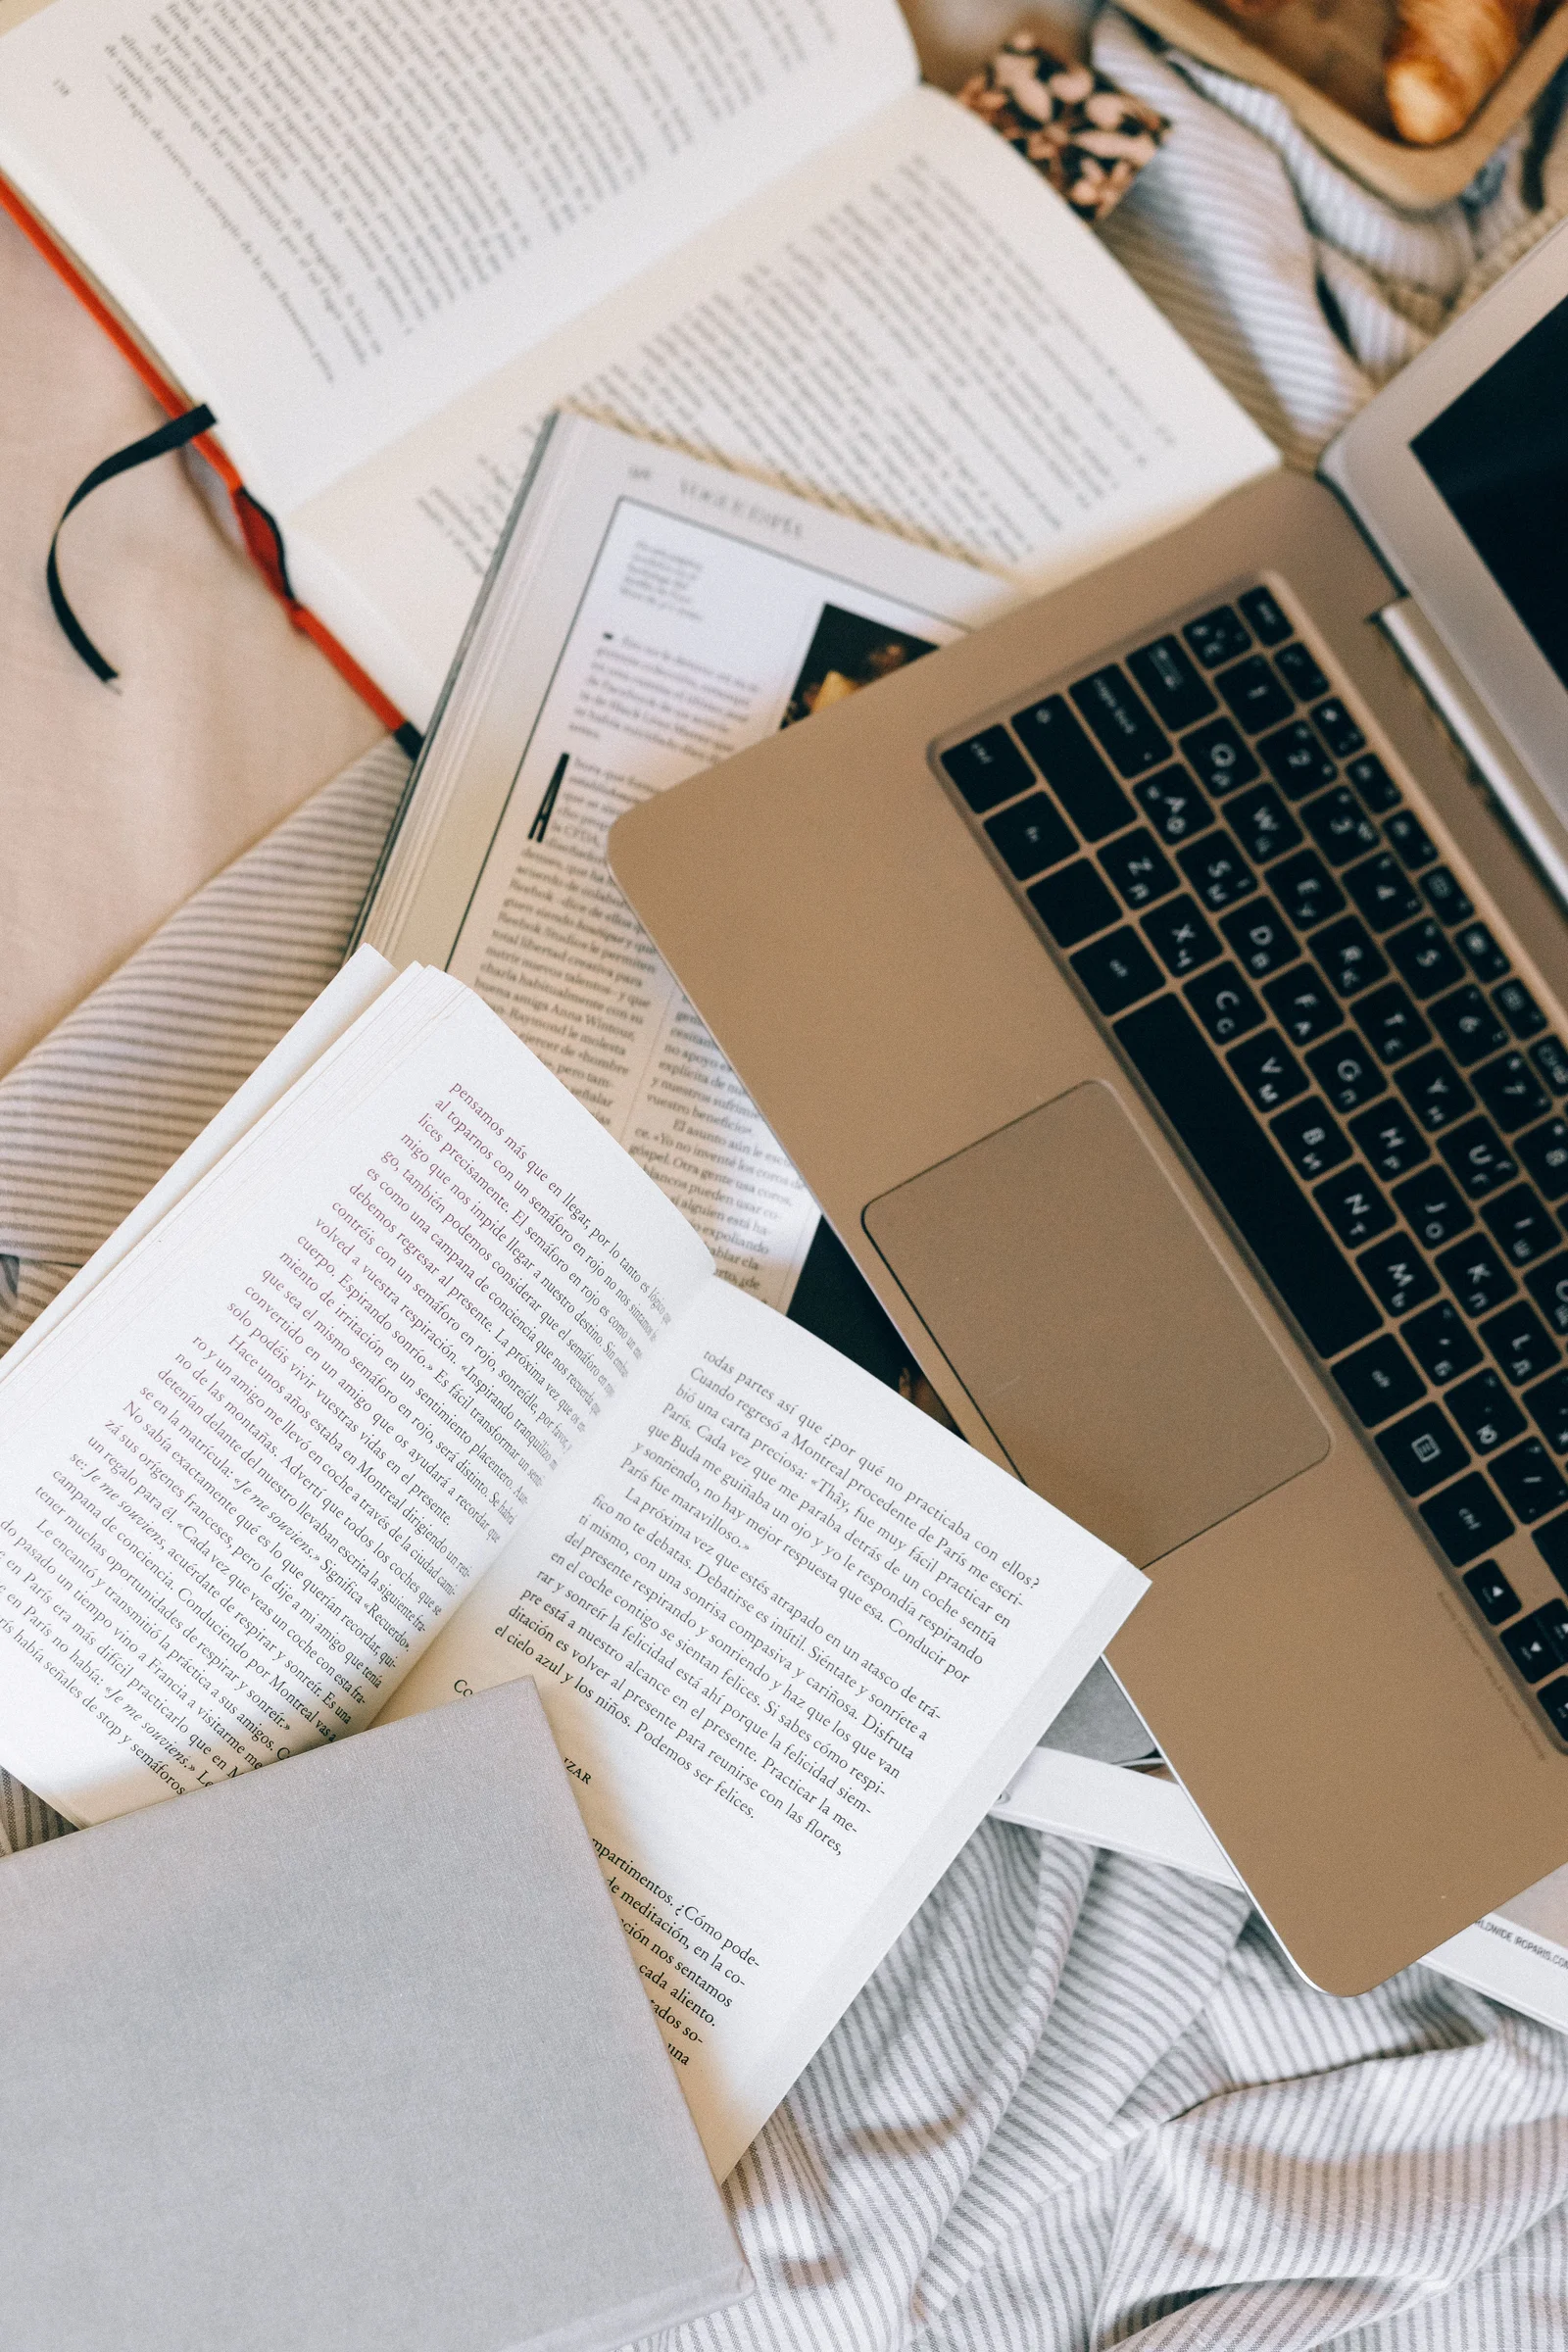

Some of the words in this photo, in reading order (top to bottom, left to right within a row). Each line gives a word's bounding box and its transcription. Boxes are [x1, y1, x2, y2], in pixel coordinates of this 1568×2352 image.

[528, 752, 570, 843] A
[1215, 990, 1240, 1010] C
[1261, 1057, 1283, 1074] V
[448, 1082, 505, 1137] pensamos
[503, 1136, 527, 1160] más
[525, 1159, 549, 1182] que
[548, 1182, 563, 1198] en
[561, 1192, 591, 1230] llegar,
[587, 1227, 611, 1247] por
[608, 1242, 620, 1259] lo
[618, 1256, 641, 1283] tanto
[639, 1281, 651, 1294] es
[1469, 1145, 1494, 1165] U
[1345, 1194, 1370, 1215] N
[1388, 1262, 1414, 1287] M
[227, 1334, 259, 1367] Hace
[257, 1365, 285, 1394] unos
[283, 1393, 311, 1419] años
[309, 1418, 343, 1452] estaba
[342, 1449, 358, 1465] en
[355, 1459, 408, 1510] Montreal
[401, 1505, 448, 1554] dirigiendo
[445, 1550, 459, 1566] un
[455, 1561, 472, 1578] reti-
[619, 1456, 649, 1482] París
[649, 1475, 670, 1495] fue
[670, 1493, 750, 1550] maravilloso.»
[690, 1367, 735, 1401] Cuando
[735, 1398, 782, 1432] regresó
[780, 1430, 790, 1440] a
[791, 1432, 851, 1481] Montreal
[845, 1477, 917, 1530] procedente
[917, 1526, 934, 1543] de
[934, 1536, 967, 1567] París
[967, 1564, 989, 1583] me
[989, 1580, 1023, 1606] escri-
[703, 1350, 735, 1374] todas
[733, 1372, 774, 1400] partes
[776, 1399, 799, 1415] así
[798, 1413, 822, 1434] que
[823, 1433, 857, 1456] ¿por
[858, 1456, 885, 1477] qué
[885, 1476, 904, 1492] no
[904, 1491, 970, 1542] practicaba
[973, 1540, 999, 1561] con
[1002, 1559, 1040, 1589] ellos?
[139, 1387, 154, 1400] se
[153, 1399, 169, 1415] en
[167, 1409, 179, 1427] la
[178, 1424, 233, 1478] matrícula:
[232, 1478, 252, 1494] «Je
[249, 1494, 270, 1512] me
[267, 1511, 320, 1561] souviens.»
[319, 1558, 364, 1604] Significa
[364, 1602, 410, 1652] «Recuerdo».
[34, 1486, 66, 1515] tener
[64, 1515, 107, 1556] muchas
[106, 1555, 184, 1630] oportunidades
[181, 1627, 198, 1643] de
[195, 1642, 240, 1682] respirar
[233, 1680, 249, 1690] y
[245, 1689, 290, 1731] sonreír.»
[72, 1453, 87, 1470] se:
[83, 1468, 101, 1482] Je
[99, 1483, 120, 1499] me
[118, 1500, 165, 1549] souviens,
[167, 1548, 220, 1598] acuérdate
[219, 1596, 235, 1612] de
[233, 1611, 277, 1651] respirar
[271, 1650, 286, 1661] y
[284, 1659, 322, 1697] sonreír.
[320, 1690, 336, 1709] Es
[334, 1705, 352, 1725] una
[578, 1514, 592, 1526] ti
[589, 1522, 629, 1556] mismo,
[633, 1552, 657, 1572] con
[658, 1568, 681, 1590] una
[682, 1587, 727, 1622] sonrisa
[728, 1620, 793, 1671] compasiva
[791, 1667, 806, 1679] y
[806, 1677, 858, 1720] cariñosa.
[860, 1713, 913, 1760] Disfruta
[13, 1628, 44, 1663] había
[42, 1661, 83, 1698] señales
[81, 1696, 98, 1712] de
[95, 1711, 122, 1736] stop
[117, 1734, 132, 1744] y
[129, 1743, 186, 1795] semáforos
[494, 1624, 510, 1638] el
[506, 1633, 534, 1656] cielo
[534, 1653, 565, 1676] azul
[559, 1672, 574, 1685] y
[573, 1676, 595, 1698] los
[594, 1695, 630, 1728] niños.
[633, 1720, 693, 1771] Podemos
[692, 1768, 714, 1786] ser
[712, 1780, 754, 1819] felices.
[619, 1890, 689, 1949] meditación,
[693, 1945, 710, 1961] en
[710, 1953, 722, 1972] la
[724, 1969, 745, 1985] co-
[620, 1918, 650, 1946] ción
[650, 1943, 674, 1964] nos
[674, 1961, 732, 2007] sentamos
[674, 1904, 722, 1940] ¿Cómo
[720, 1937, 759, 1966] pode-
[638, 1964, 667, 1989] cada
[669, 1987, 714, 2027] aliento.
[650, 1999, 682, 2029] ados
[681, 2027, 703, 2043] so-
